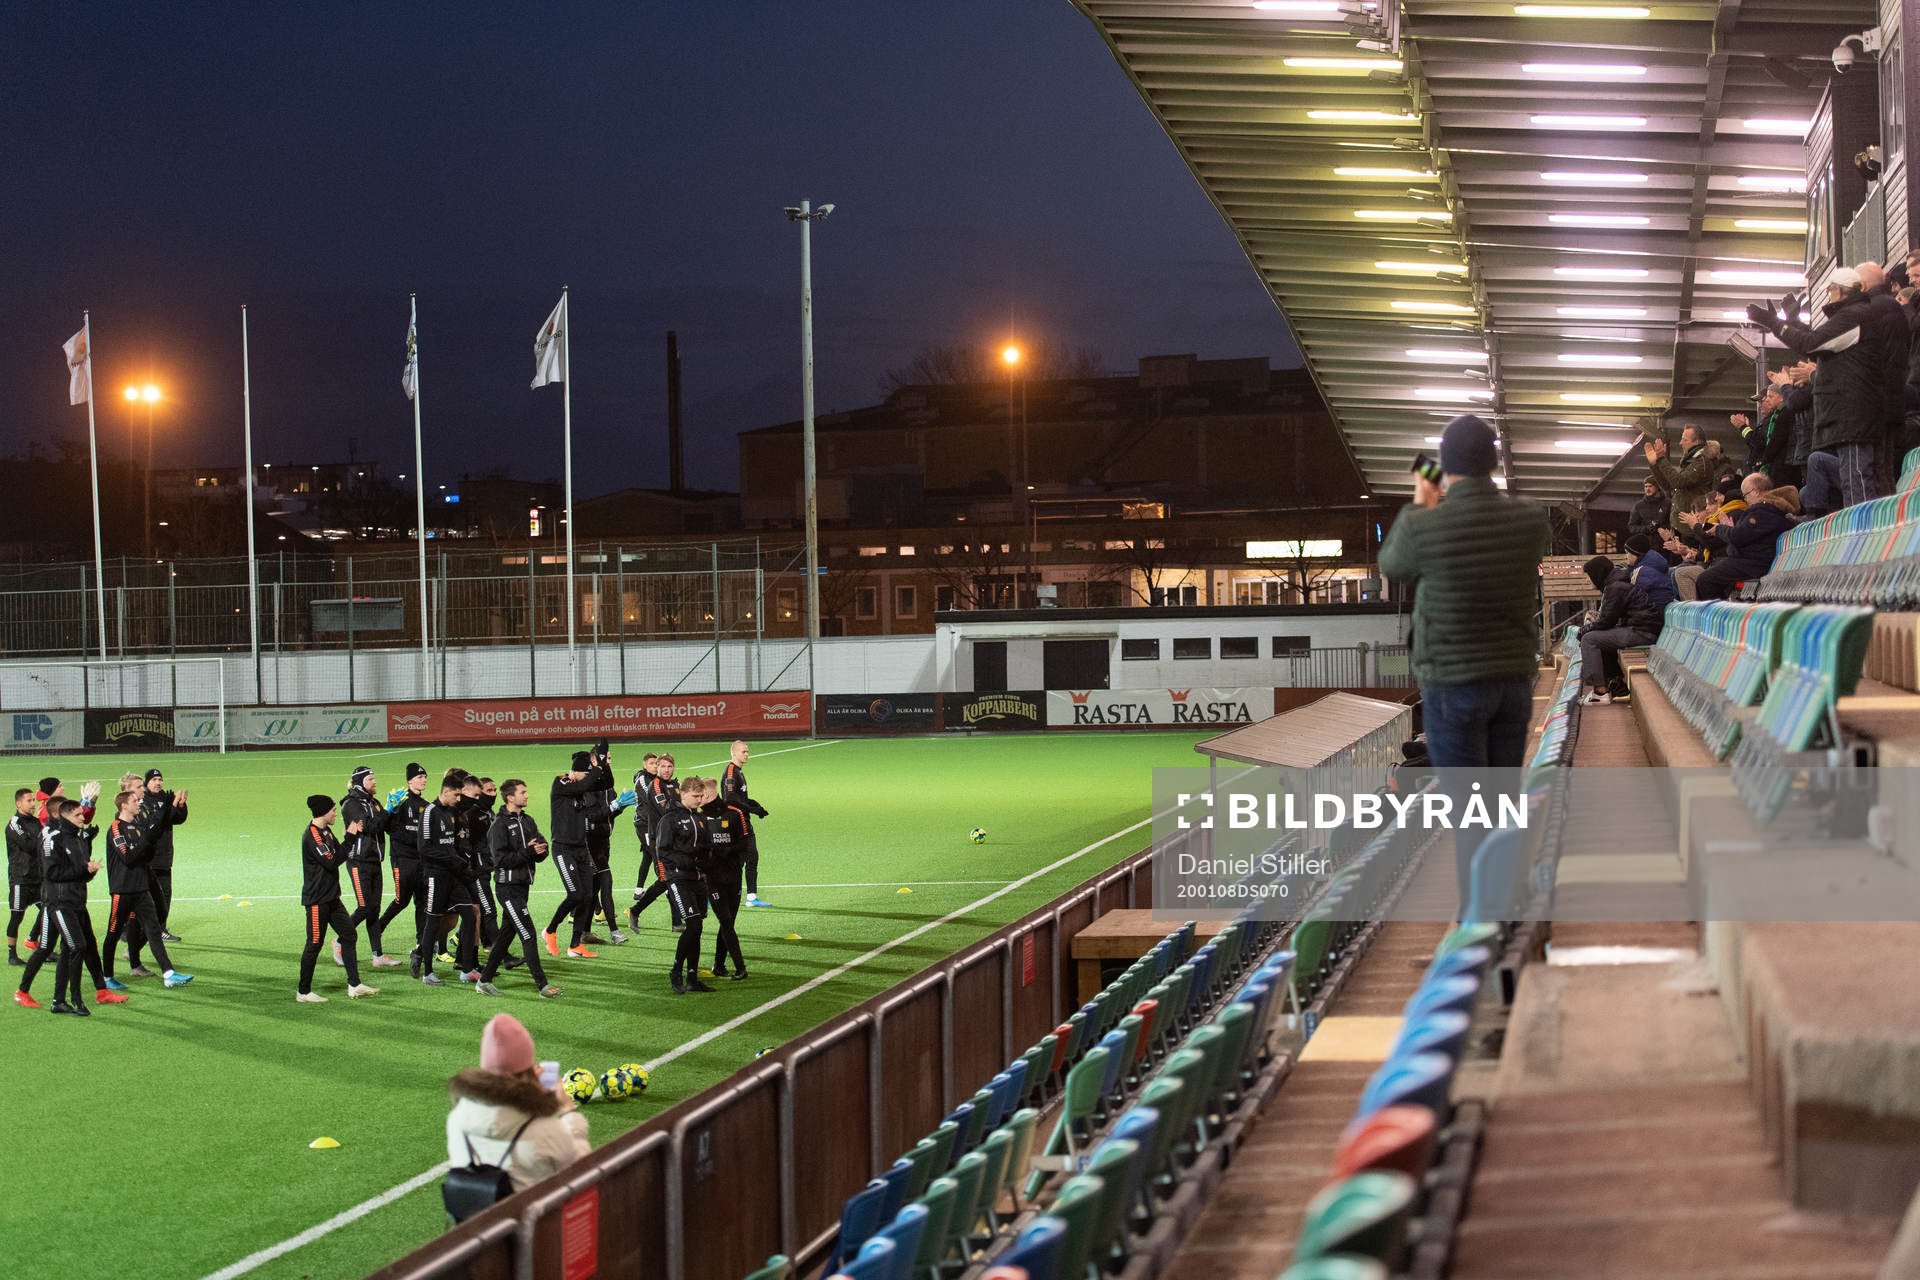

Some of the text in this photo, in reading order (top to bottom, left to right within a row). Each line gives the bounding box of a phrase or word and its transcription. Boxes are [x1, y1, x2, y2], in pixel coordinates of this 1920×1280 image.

[464, 701, 726, 725] Sugen på ett mål efter matchen?
[963, 700, 1037, 723] KOPPARBERG
[1073, 704, 1153, 725] RASTA
[1172, 702, 1254, 723] RASTA
[105, 718, 174, 740] KOPPARBERG
[495, 727, 546, 735] Restauranger
[563, 724, 599, 734] shopping
[649, 721, 665, 730] från
[666, 721, 696, 730] Valhalla
